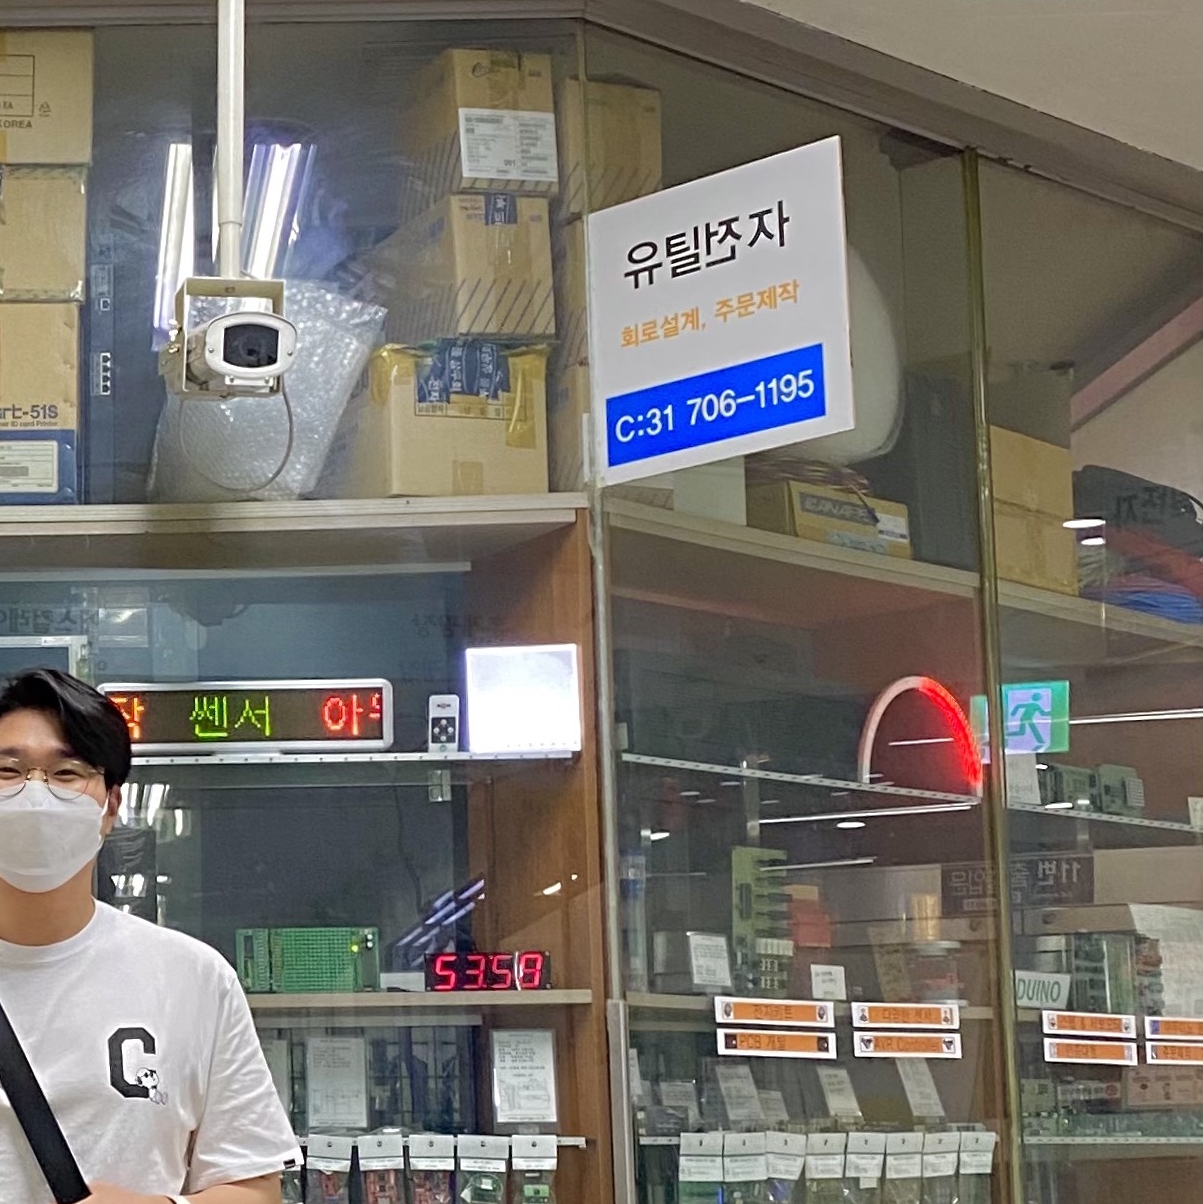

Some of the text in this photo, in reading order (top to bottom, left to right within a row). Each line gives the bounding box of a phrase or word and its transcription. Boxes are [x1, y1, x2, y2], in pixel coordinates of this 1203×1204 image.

[621, 278, 800, 348] 회로설계, 주문제작
[614, 369, 815, 442] C:31 706-1195
[1017, 977, 1062, 1002] DUINO
[107, 1026, 157, 1099] C
